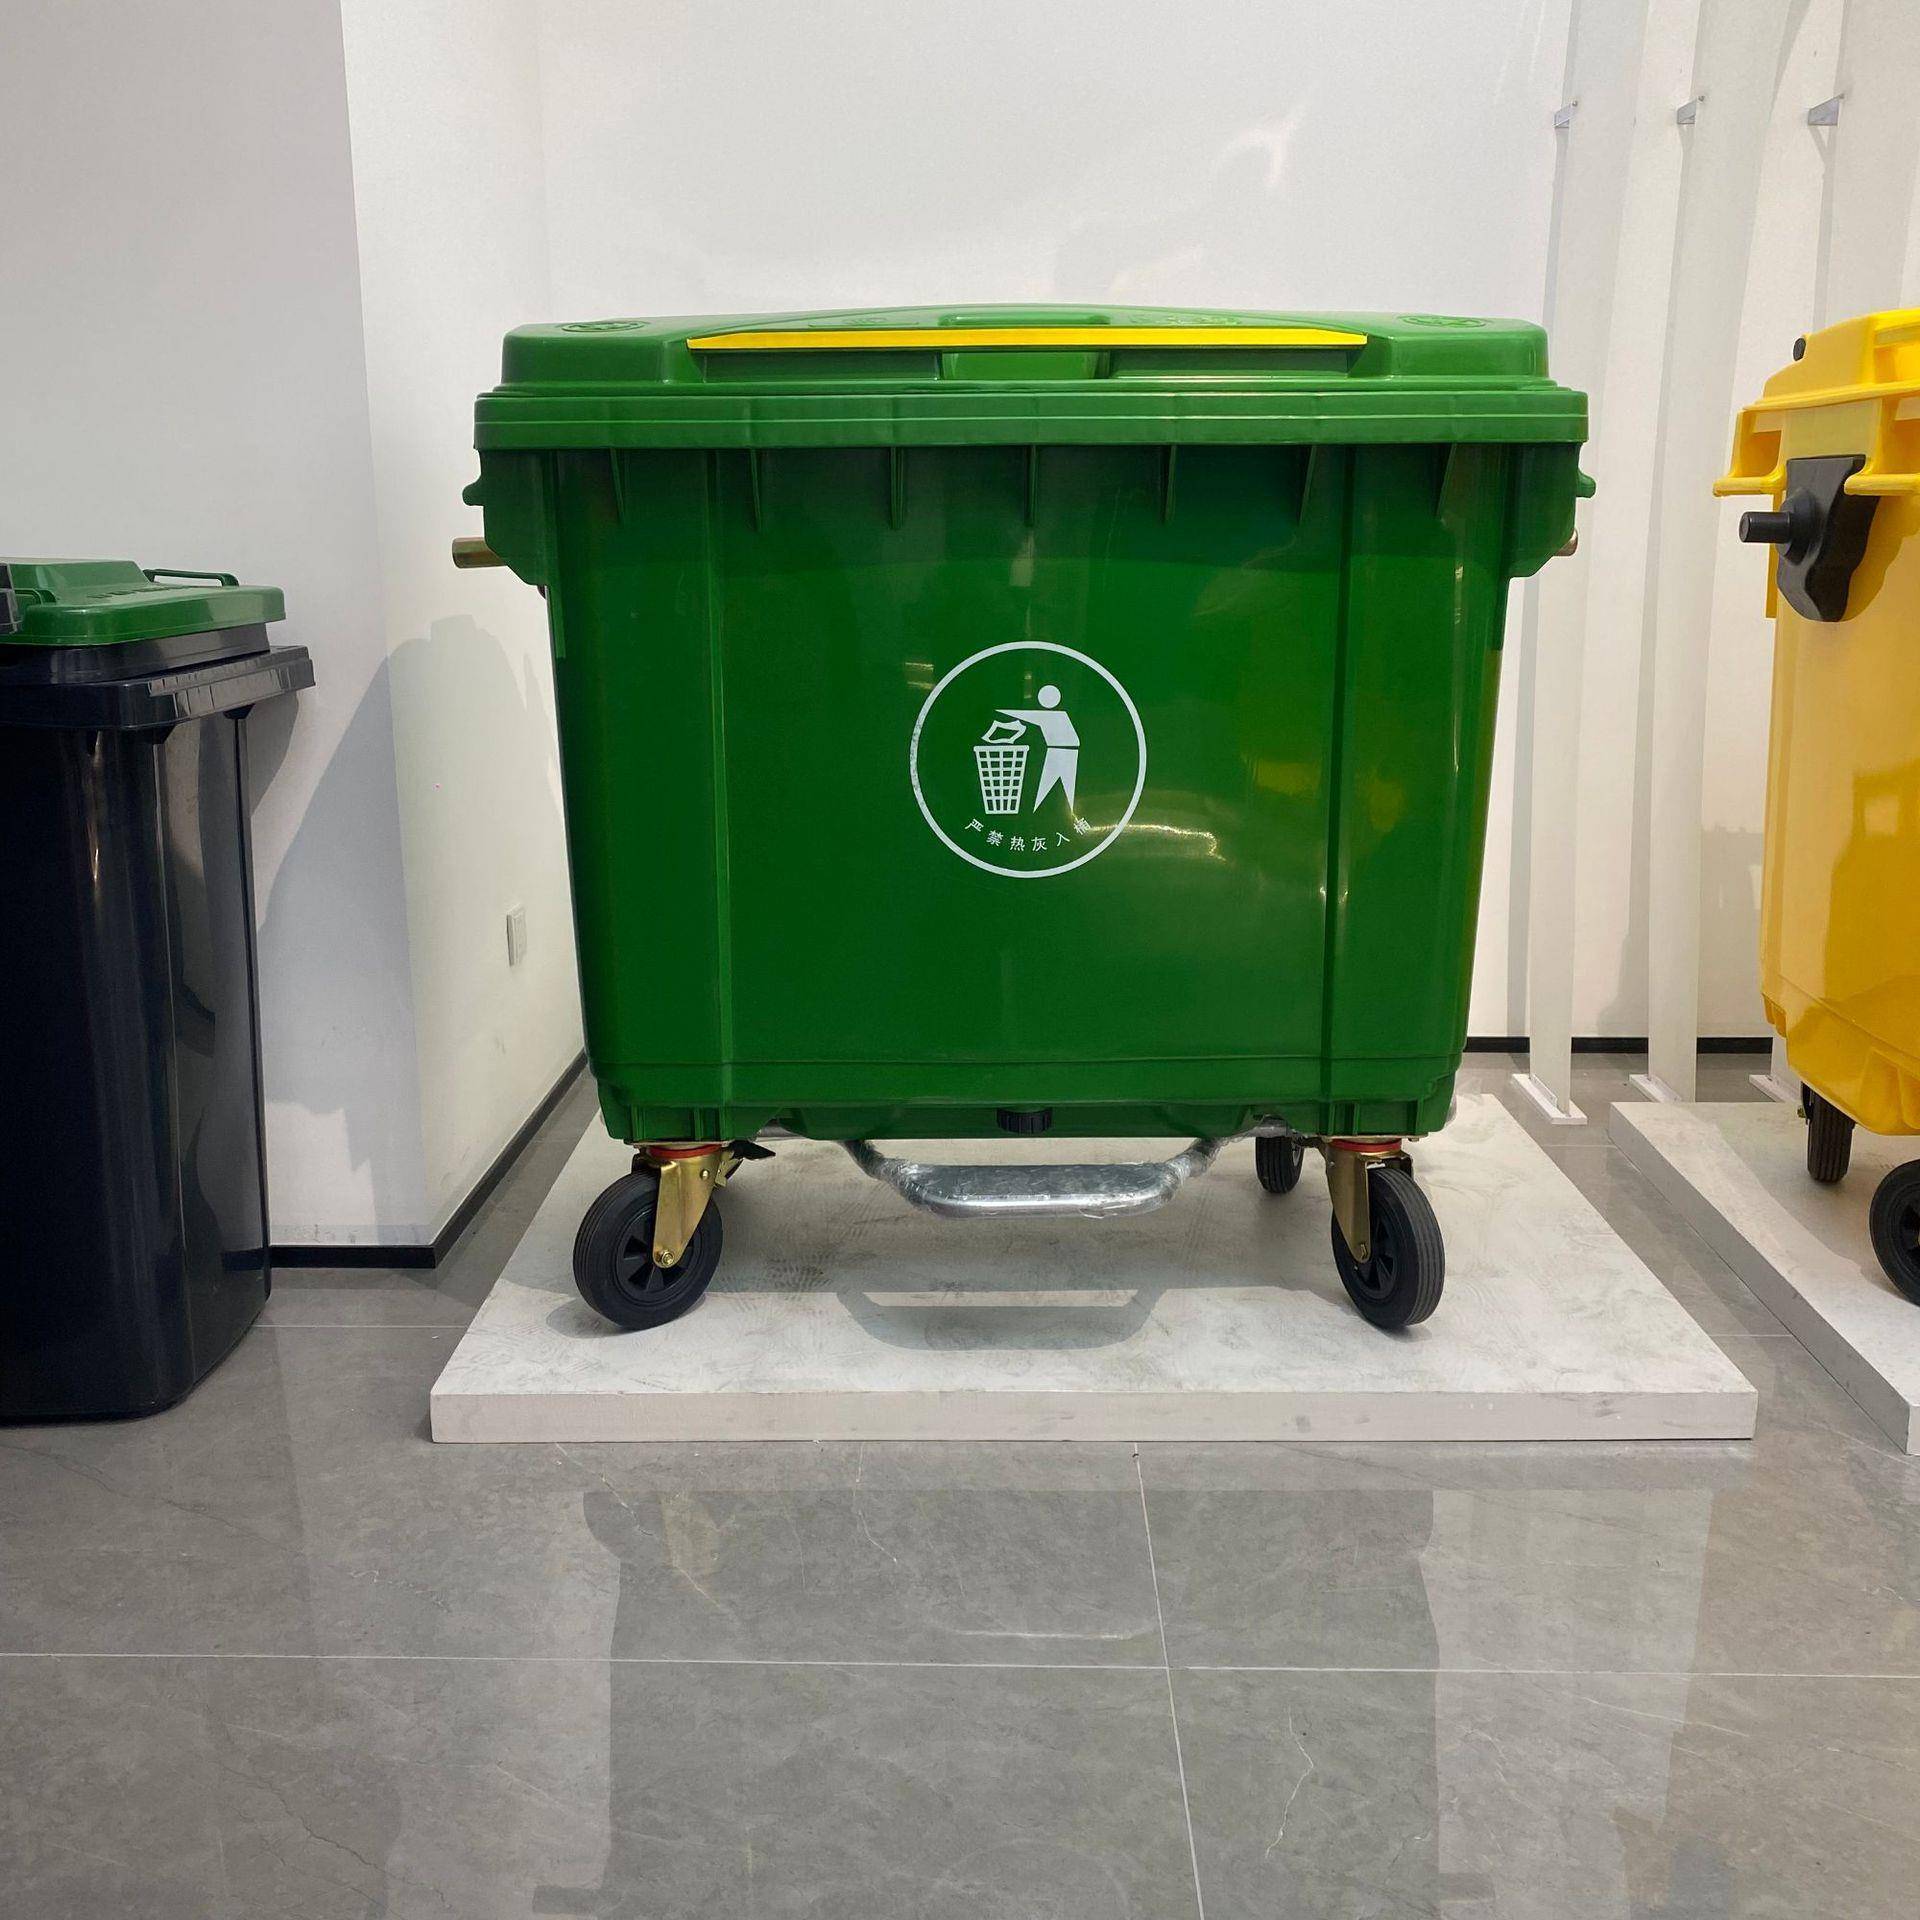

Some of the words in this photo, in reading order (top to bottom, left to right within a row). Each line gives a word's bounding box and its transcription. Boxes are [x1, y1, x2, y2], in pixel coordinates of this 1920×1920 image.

[964, 818, 1091, 852] 严禁热灰入桶
